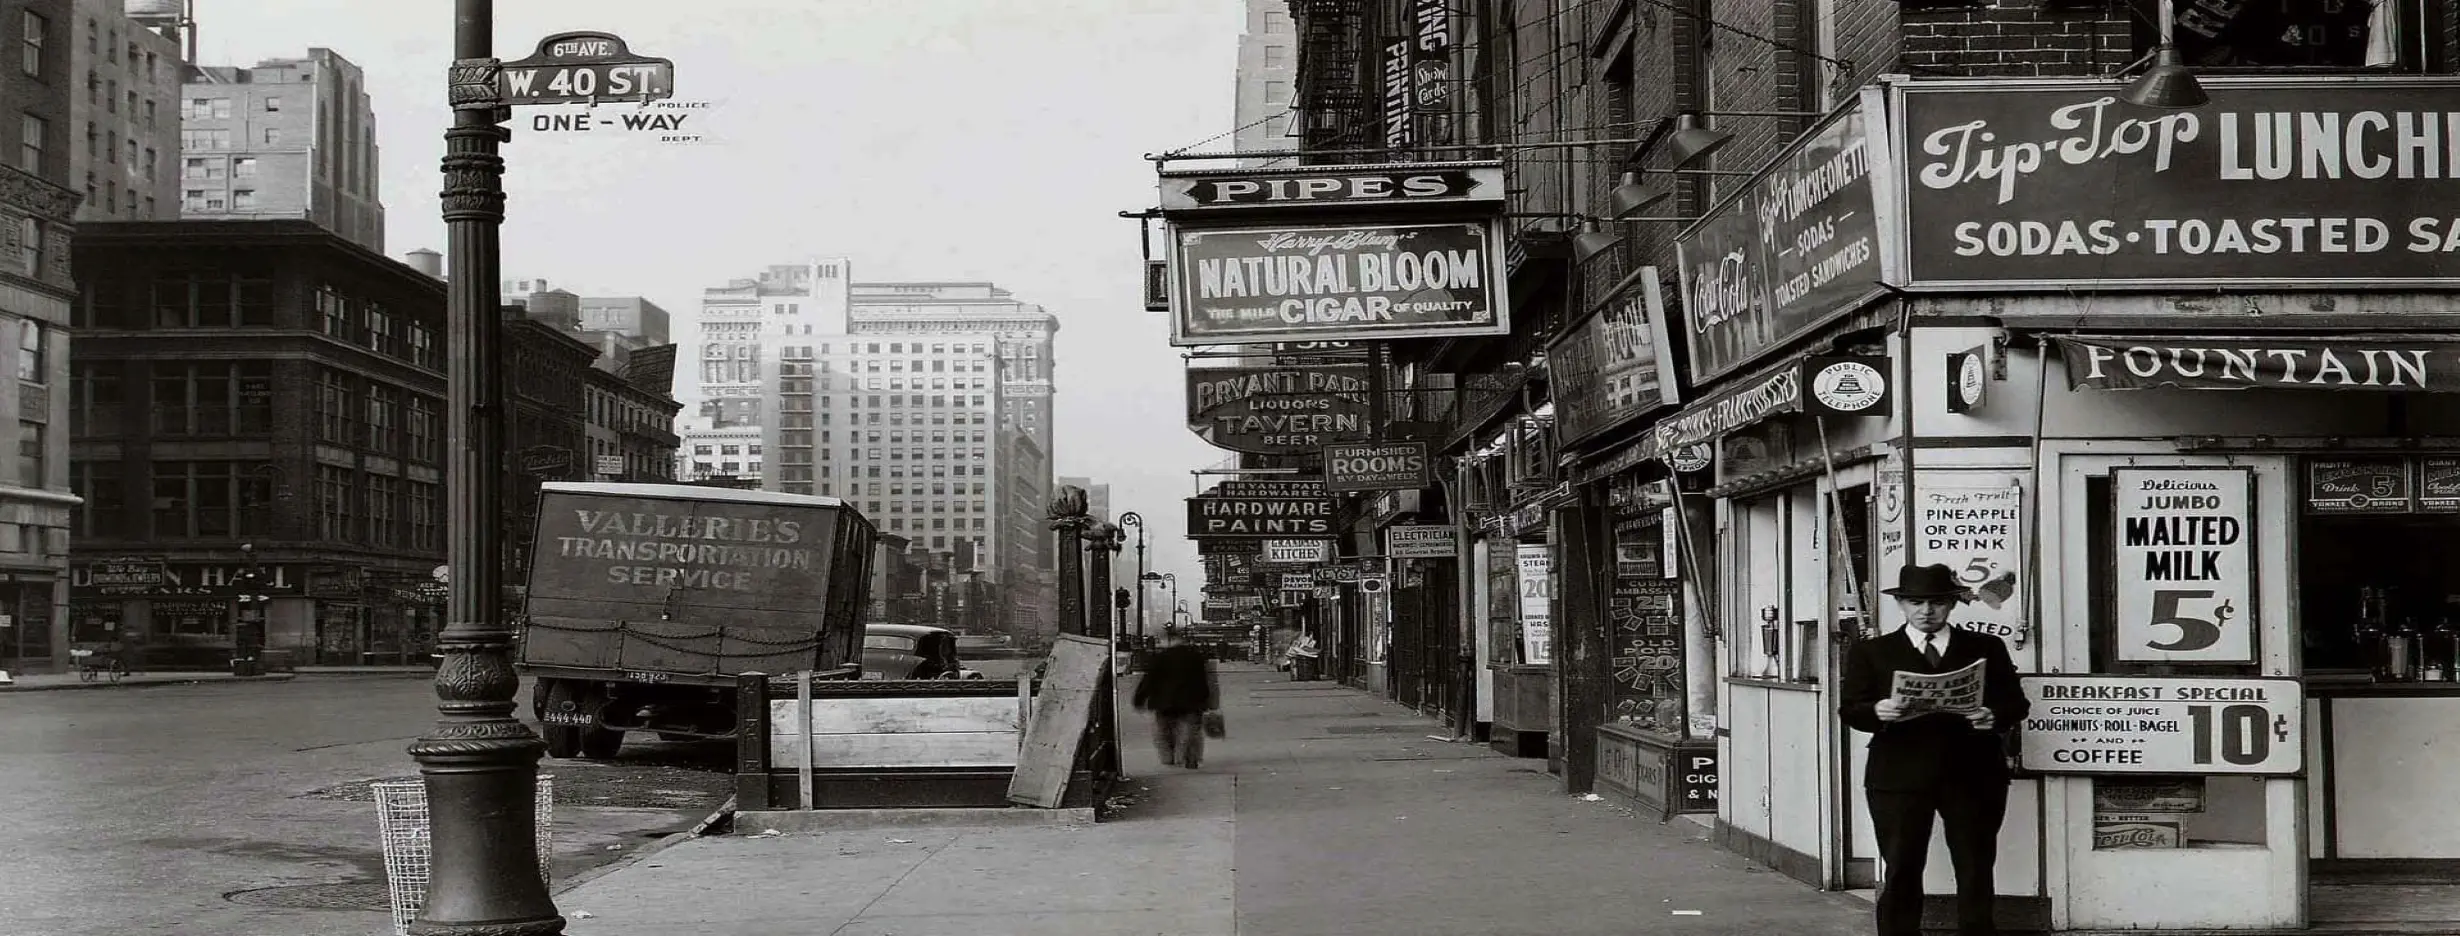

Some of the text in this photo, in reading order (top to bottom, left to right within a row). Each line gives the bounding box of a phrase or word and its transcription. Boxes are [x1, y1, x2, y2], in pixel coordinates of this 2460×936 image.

[1417, 0, 1448, 52] ING
[579, 42, 612, 57] AVE.
[506, 67, 661, 97] W. 40 ST.
[1417, 67, 1446, 88] Show
[1418, 82, 1446, 106] Cards
[657, 102, 712, 110] POLICE
[533, 114, 590, 131] ONE
[621, 114, 688, 131] WAY
[1920, 96, 2200, 205] Tip-Top
[1211, 174, 1449, 202] PIPES
[1257, 231, 1334, 256] Harry
[1797, 215, 1835, 257] SODAS
[1200, 249, 1479, 298] NATURAL BLOOM
[1775, 237, 1870, 309] TOASTED SANDWICHES
[1279, 296, 1394, 324] CIGAR
[1393, 303, 1409, 313] OF
[1413, 300, 1472, 313] QUALITY
[1824, 363, 1873, 375] PUBLIC
[2086, 345, 2431, 389] FOUNTAIN
[1197, 372, 1300, 410] BRYANT
[1818, 391, 1881, 410] TELEPHONE
[1250, 399, 1330, 410] LIQUORS
[1217, 414, 1359, 435] TAVERN
[1263, 435, 1318, 445] BEER
[1335, 447, 1416, 457] FURNISHED
[1332, 456, 1422, 474] ROOMS
[2140, 479, 2219, 491] Delicious
[1929, 491, 2010, 505] Fresh Fruit
[2141, 495, 2221, 510] JUMBO
[1203, 502, 1331, 516] HARDWARE
[1927, 509, 2016, 521] PINEAPPLE
[575, 510, 800, 544] VALLERIE'S
[1208, 519, 1328, 532] PAINTS
[1925, 524, 2008, 535] OR GRAPE
[2126, 516, 2240, 546] MALTED
[558, 536, 809, 570] TRANSPORTATION
[1271, 548, 1320, 559] KITCHEN
[1929, 539, 2005, 550] DRINK
[2145, 551, 2222, 581] MILK
[607, 566, 750, 591] SERVICE
[2146, 589, 2235, 651] 5¢
[2041, 685, 2267, 700] BREAKFAST SPECIAL
[2050, 706, 2160, 716] CHOICE OF JUICE
[2053, 749, 2143, 764] COFFEE
